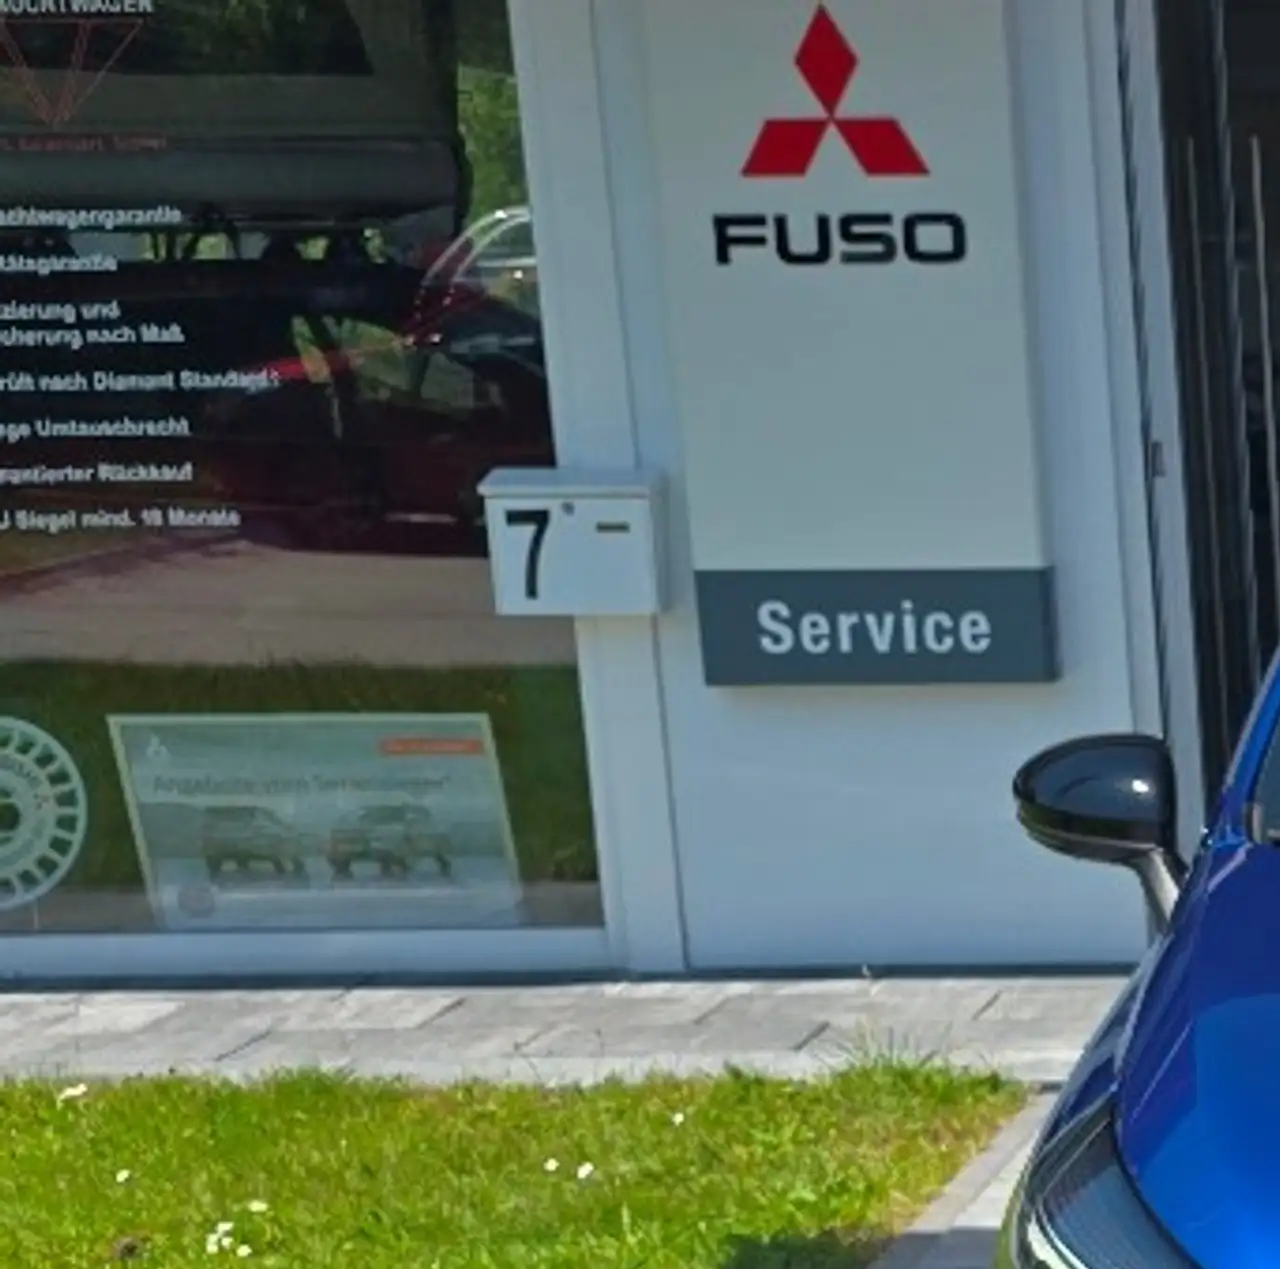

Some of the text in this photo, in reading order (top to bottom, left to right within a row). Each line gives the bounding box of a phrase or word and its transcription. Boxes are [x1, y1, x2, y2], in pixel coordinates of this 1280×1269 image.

[712, 212, 967, 266] FUSO
[34, 415, 193, 438] Umtauschrecht
[14, 508, 77, 534] Siegel
[503, 509, 550, 600] 7
[756, 600, 993, 656] Service
